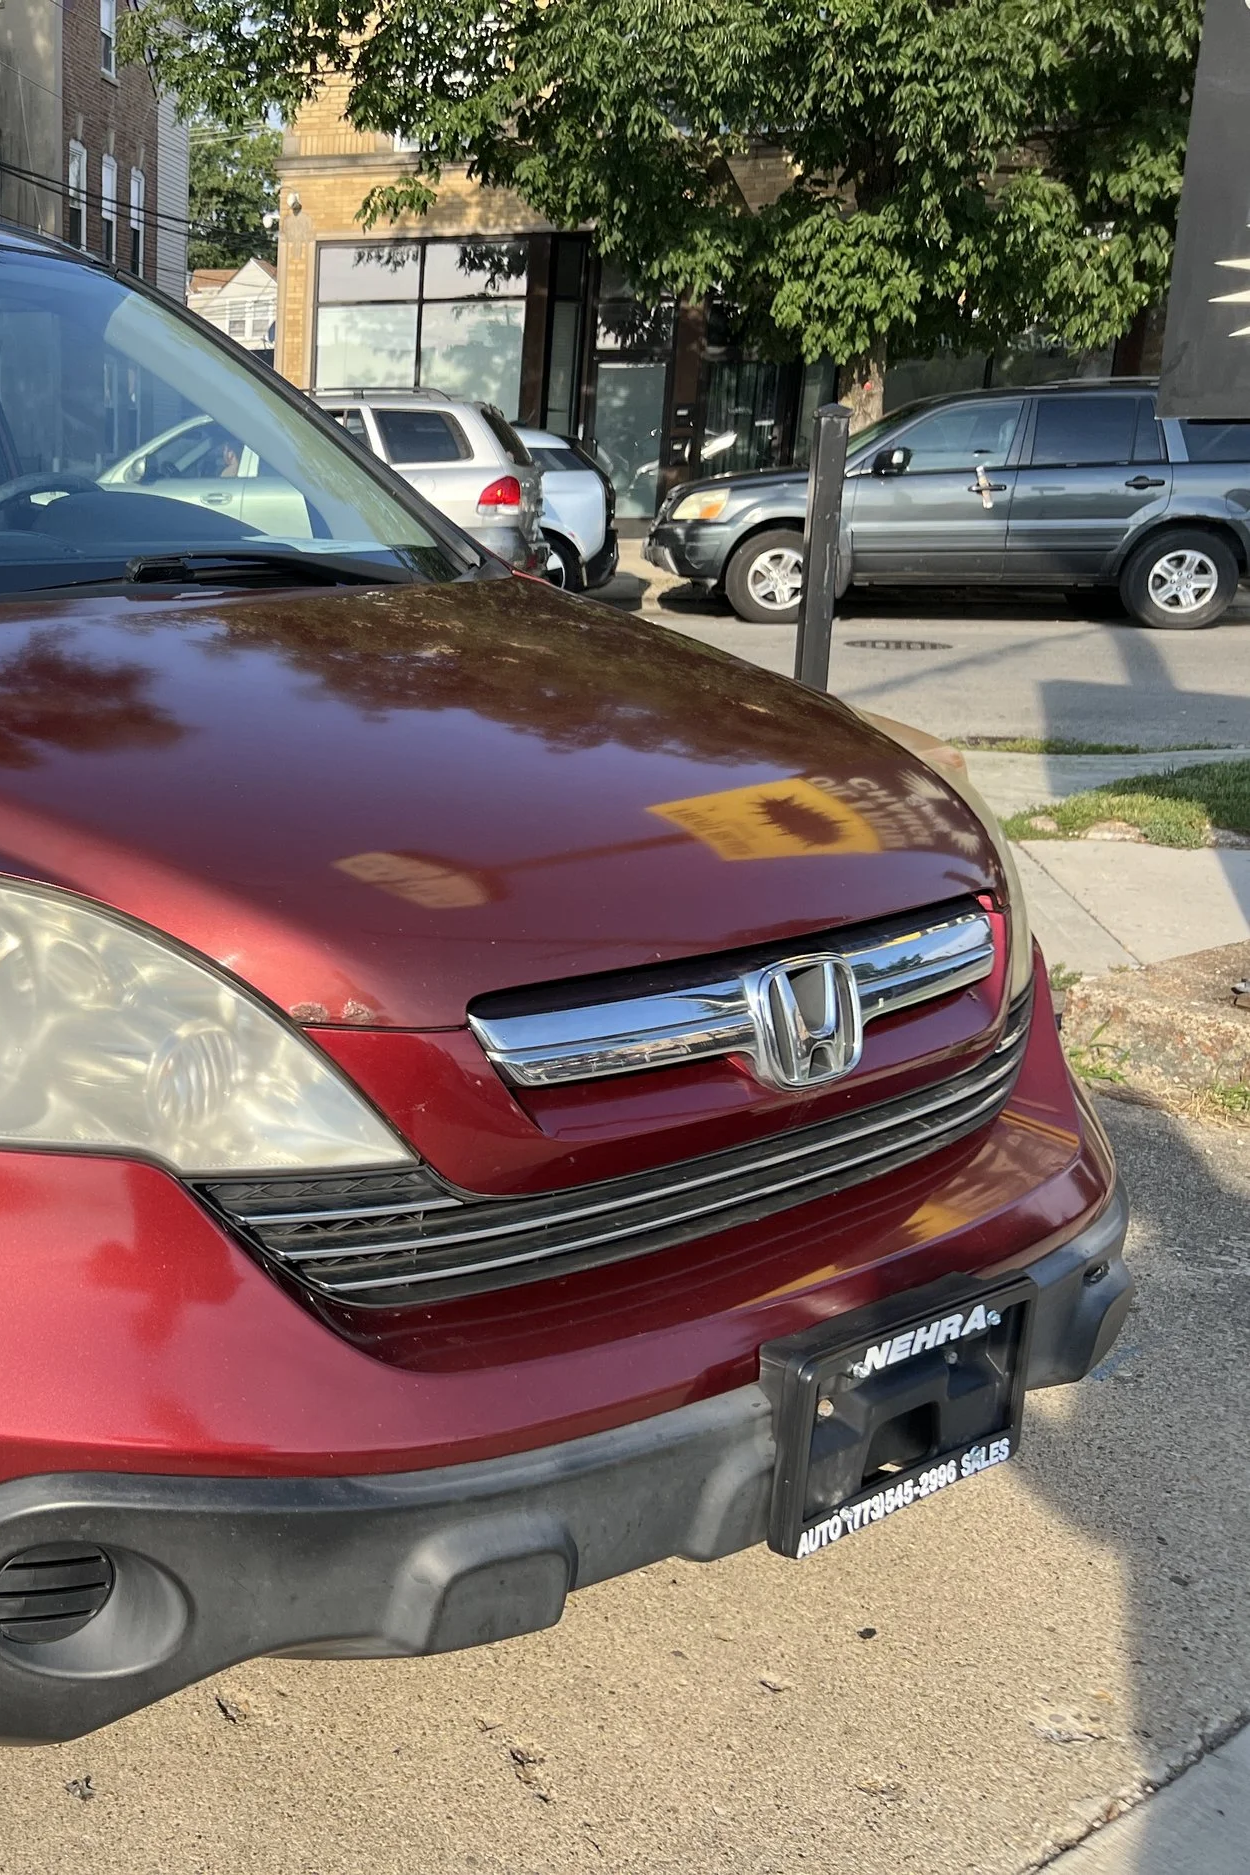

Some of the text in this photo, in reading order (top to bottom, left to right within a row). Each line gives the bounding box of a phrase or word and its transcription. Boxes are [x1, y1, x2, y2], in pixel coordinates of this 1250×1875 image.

[863, 1304, 988, 1370] NEHRA
[796, 1514, 843, 1559] AUTO
[960, 1437, 1010, 1478] SALES
